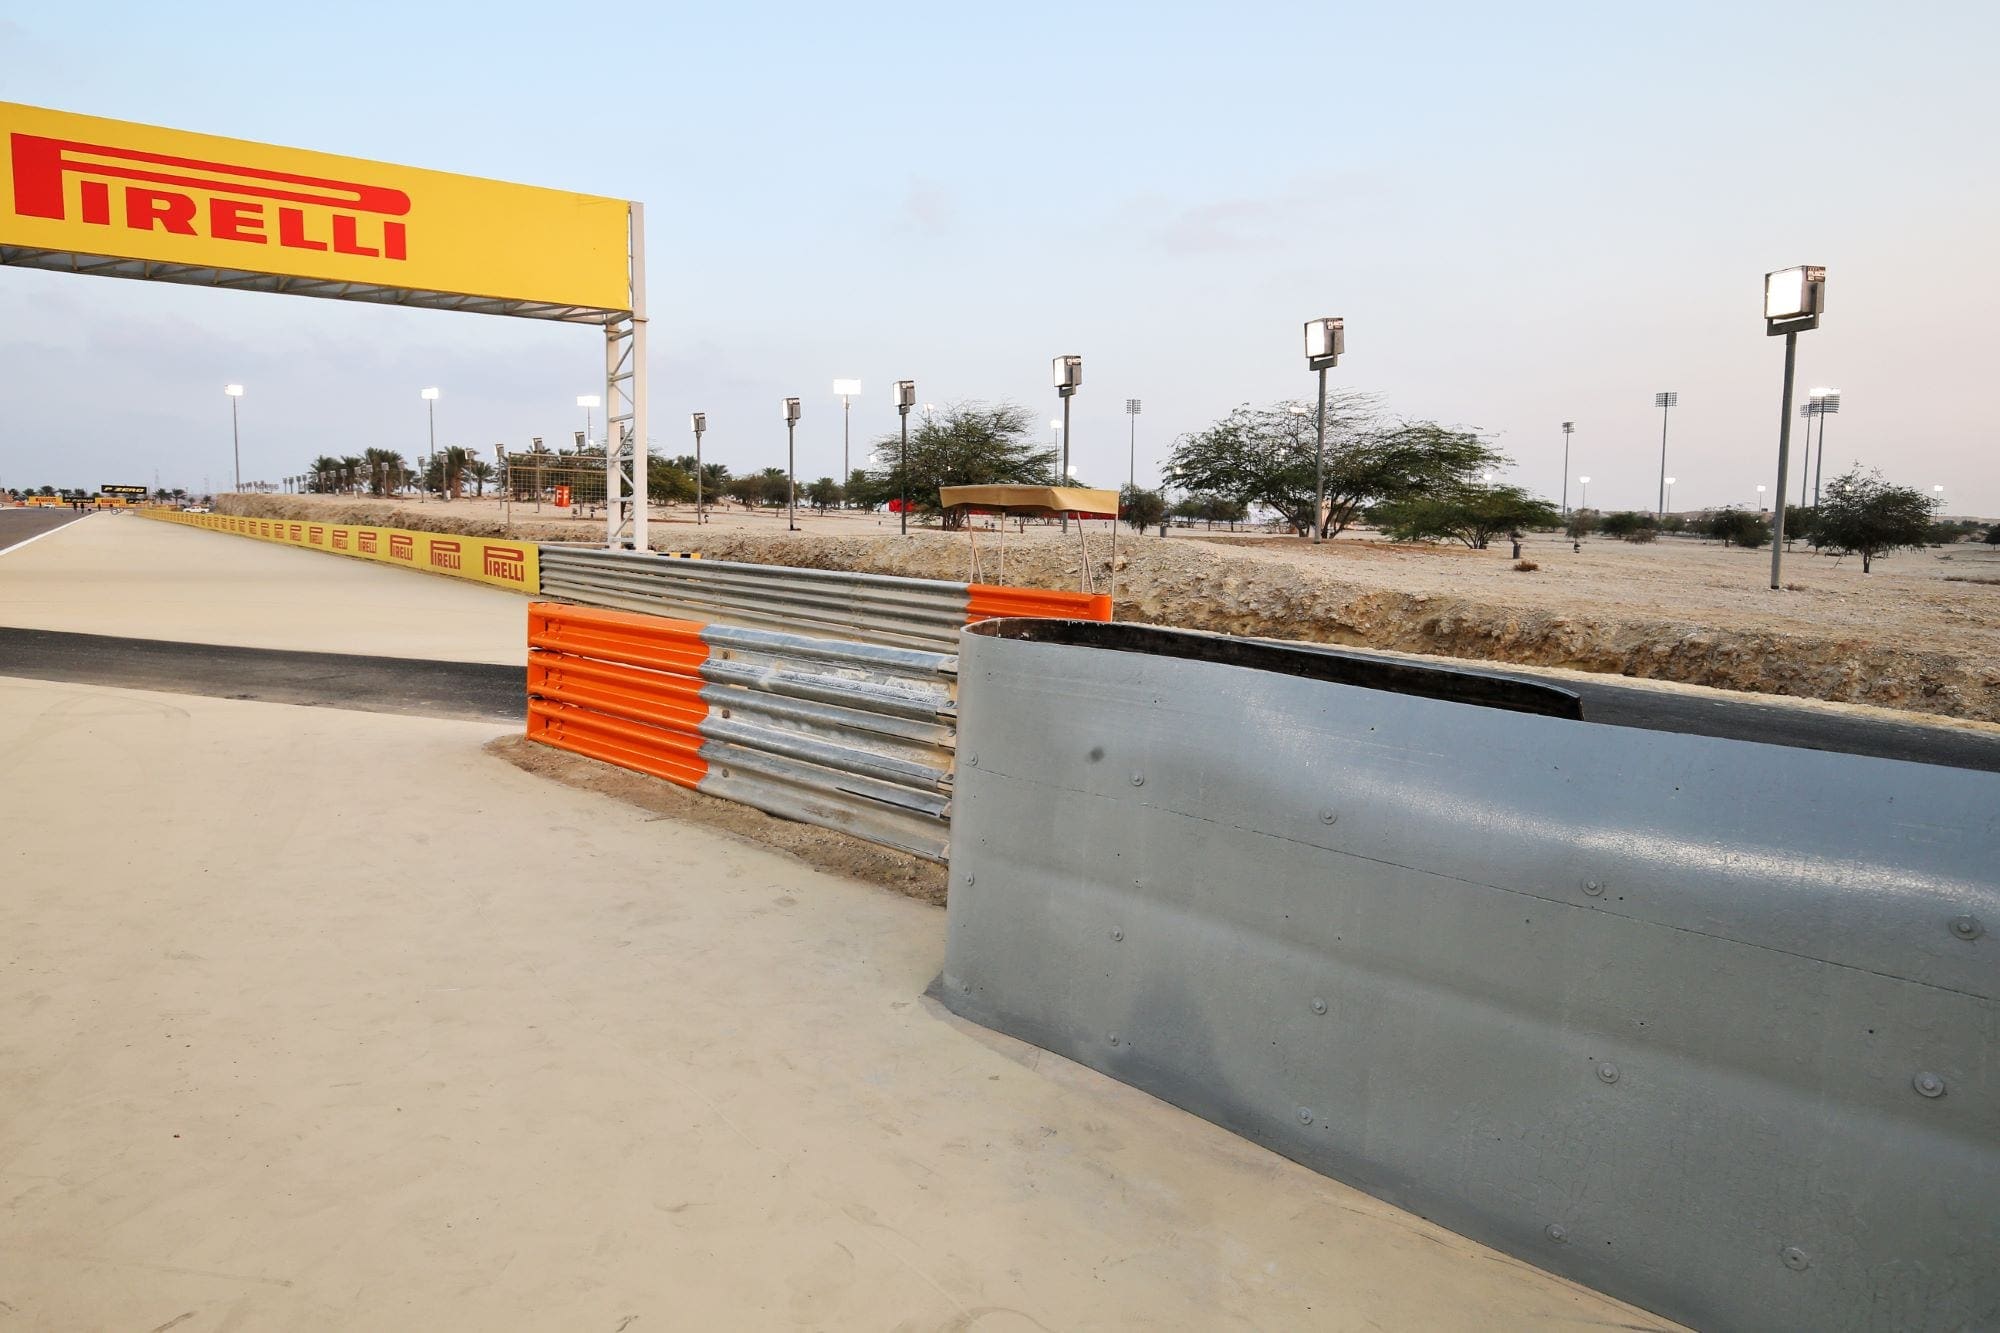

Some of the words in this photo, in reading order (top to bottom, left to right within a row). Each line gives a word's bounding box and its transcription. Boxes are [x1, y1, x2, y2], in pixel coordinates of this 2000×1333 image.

[11, 133, 411, 260] PIRELLI
[390, 535, 413, 560] PIRELLI
[431, 540, 460, 570] PIRELLI
[484, 546, 525, 582] PIRELLI
